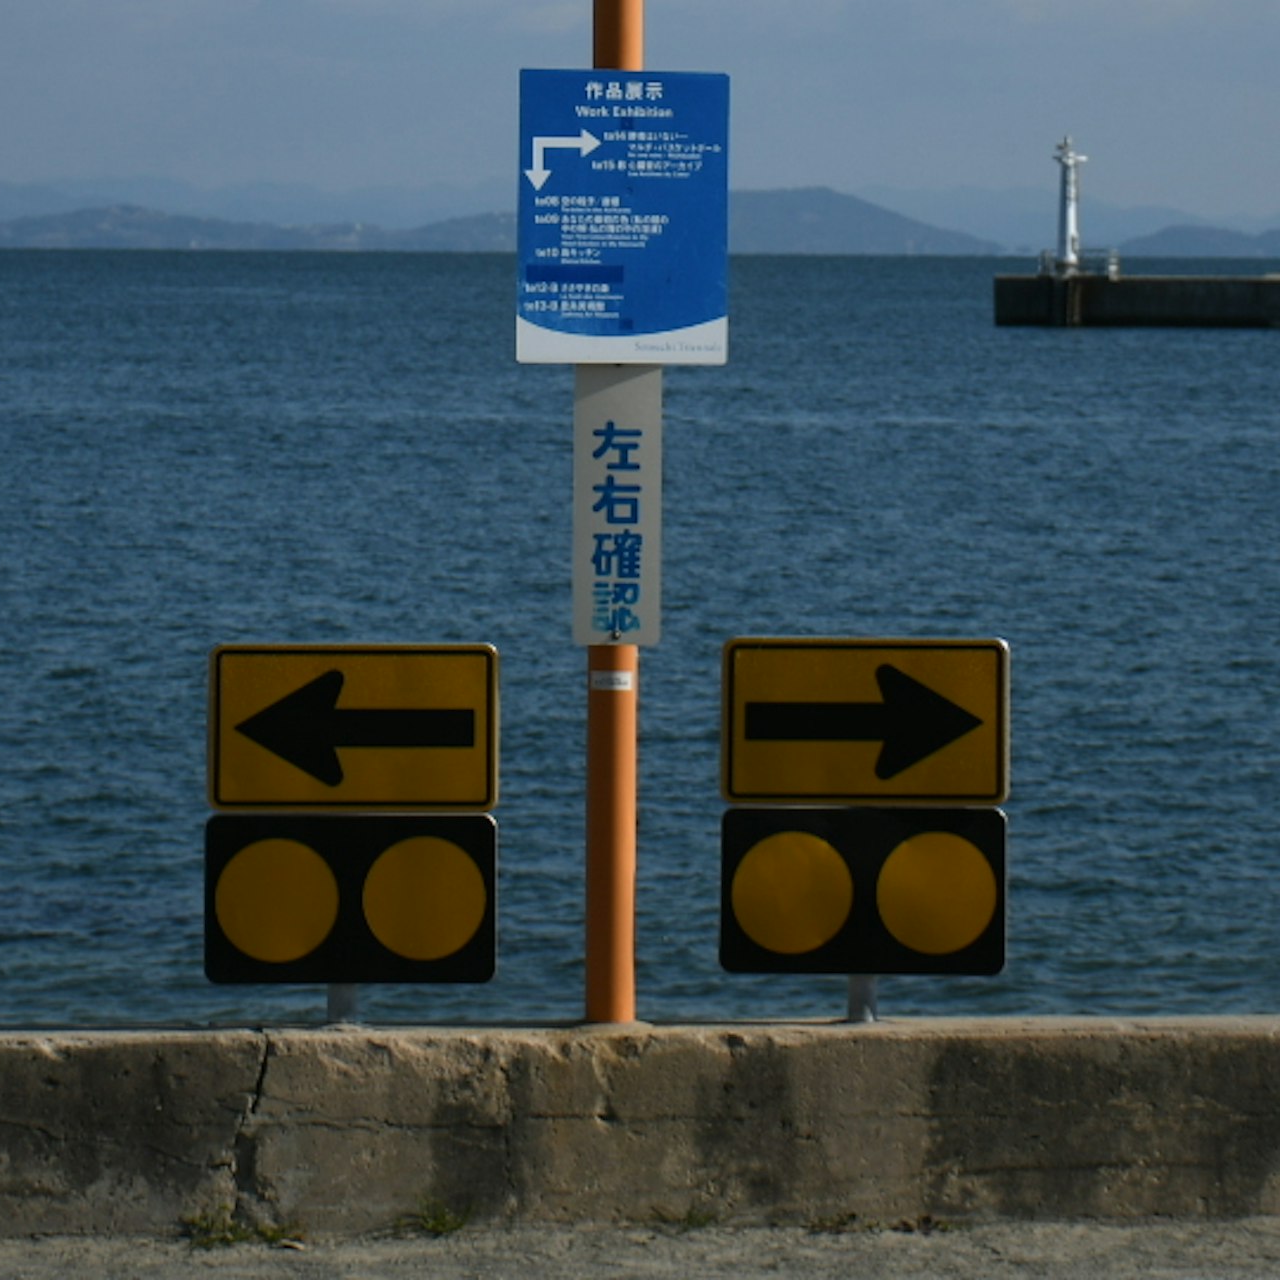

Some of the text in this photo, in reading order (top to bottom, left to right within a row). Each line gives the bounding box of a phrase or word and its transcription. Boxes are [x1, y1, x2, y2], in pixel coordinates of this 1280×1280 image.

[585, 81, 663, 101] 作品展示
[575, 106, 673, 117] Work Exhibition
[592, 421, 642, 633] 左右確認
